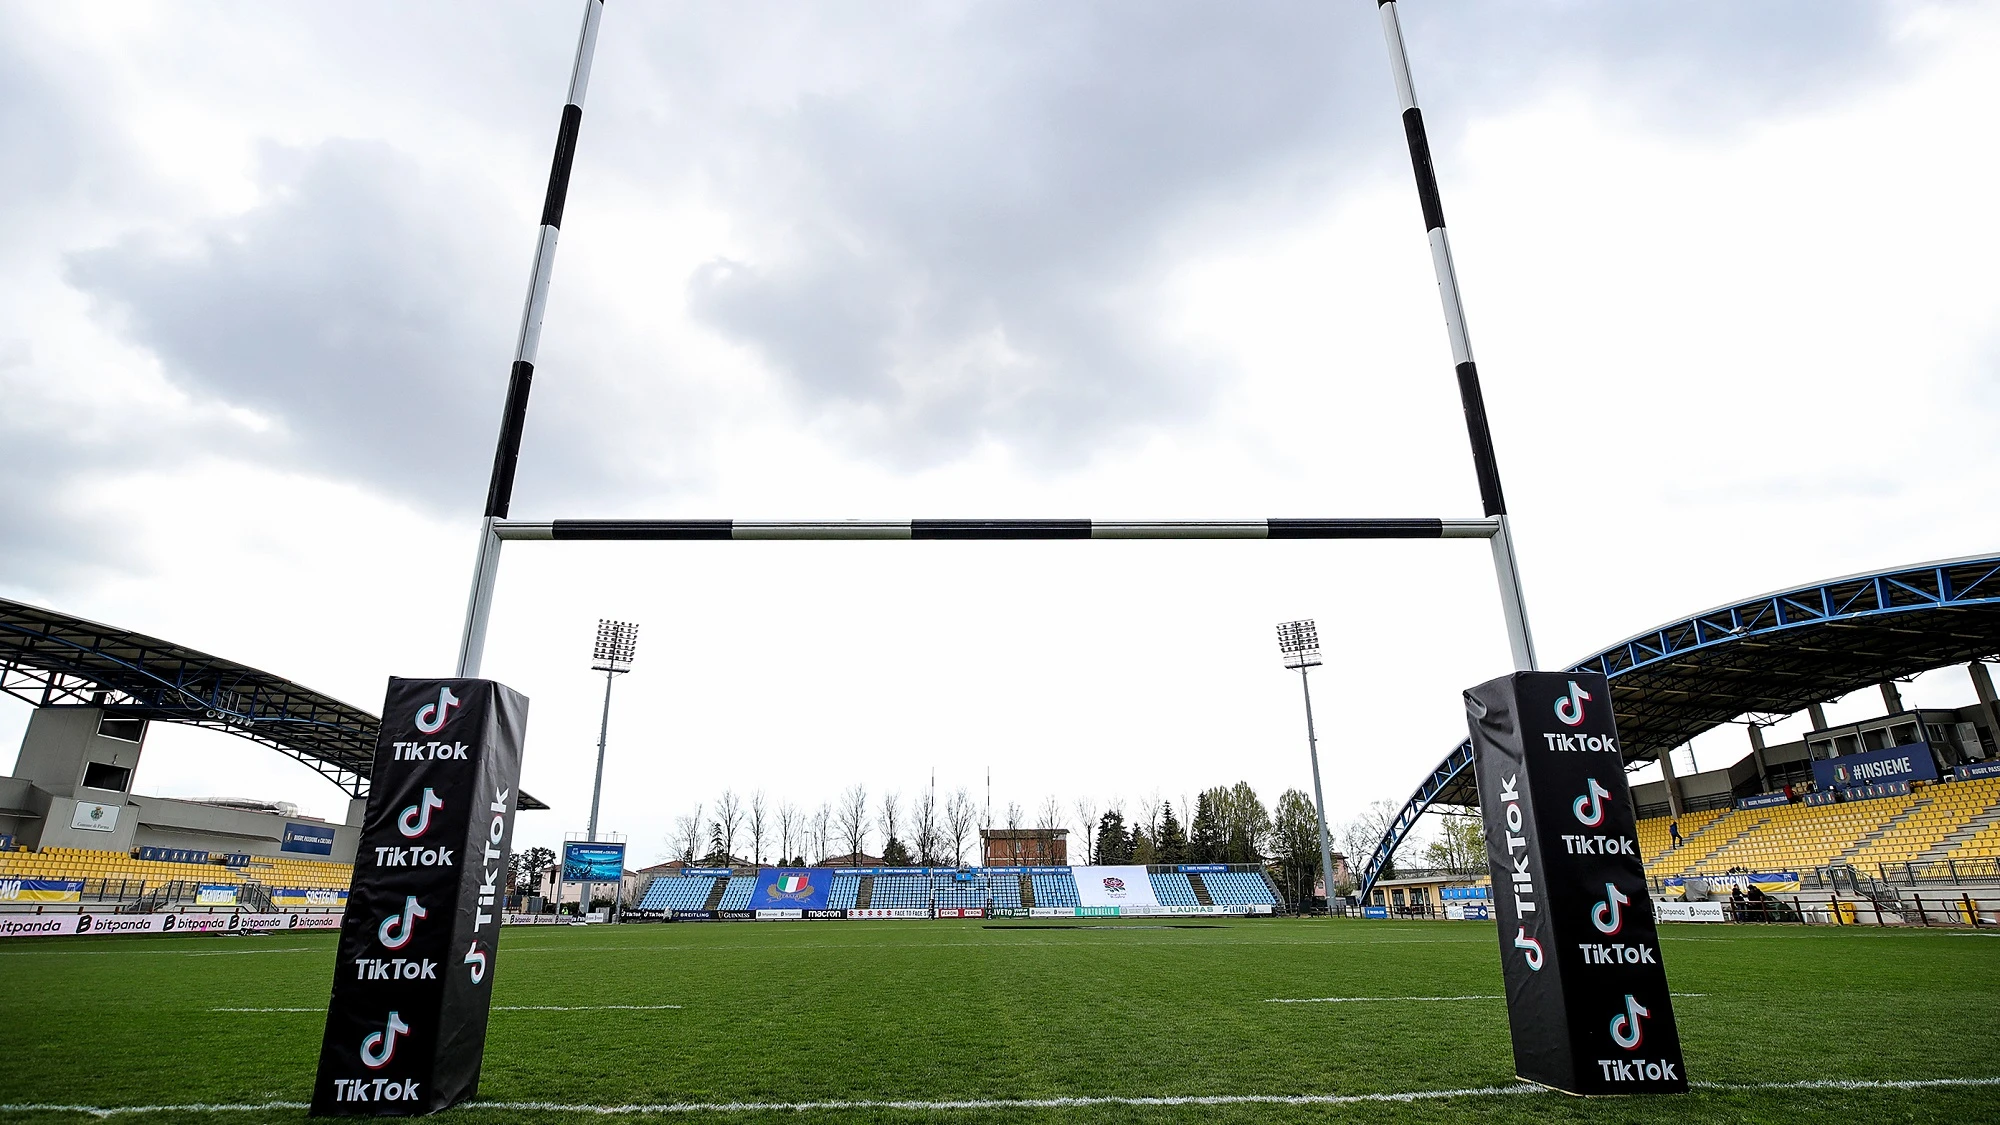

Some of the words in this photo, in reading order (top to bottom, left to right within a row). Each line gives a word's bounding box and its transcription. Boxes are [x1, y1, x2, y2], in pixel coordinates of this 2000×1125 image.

[392, 742, 469, 761] TikTok
[1544, 733, 1617, 753] TikTok
[1853, 757, 1912, 780] #INSIEME
[1500, 773, 1538, 919] TikTok
[1561, 835, 1635, 855] TikTok
[375, 846, 453, 867] TikTok
[473, 786, 510, 932] TikTok
[305, 890, 338, 905] SOSTEGNO
[808, 910, 841, 918] macron
[1662, 908, 1685, 916] bitpanda
[1695, 908, 1720, 917] bitpanda
[0, 920, 61, 935] itpanda
[95, 919, 151, 932] bitpanda
[178, 918, 224, 930] bitpanda
[241, 917, 280, 929] bitpanda
[299, 917, 333, 928] bitpanda
[1579, 943, 1656, 964] TikTok
[356, 958, 436, 980] TikTok
[1598, 1059, 1678, 1081] TikTok
[335, 1079, 419, 1102] TikTok
